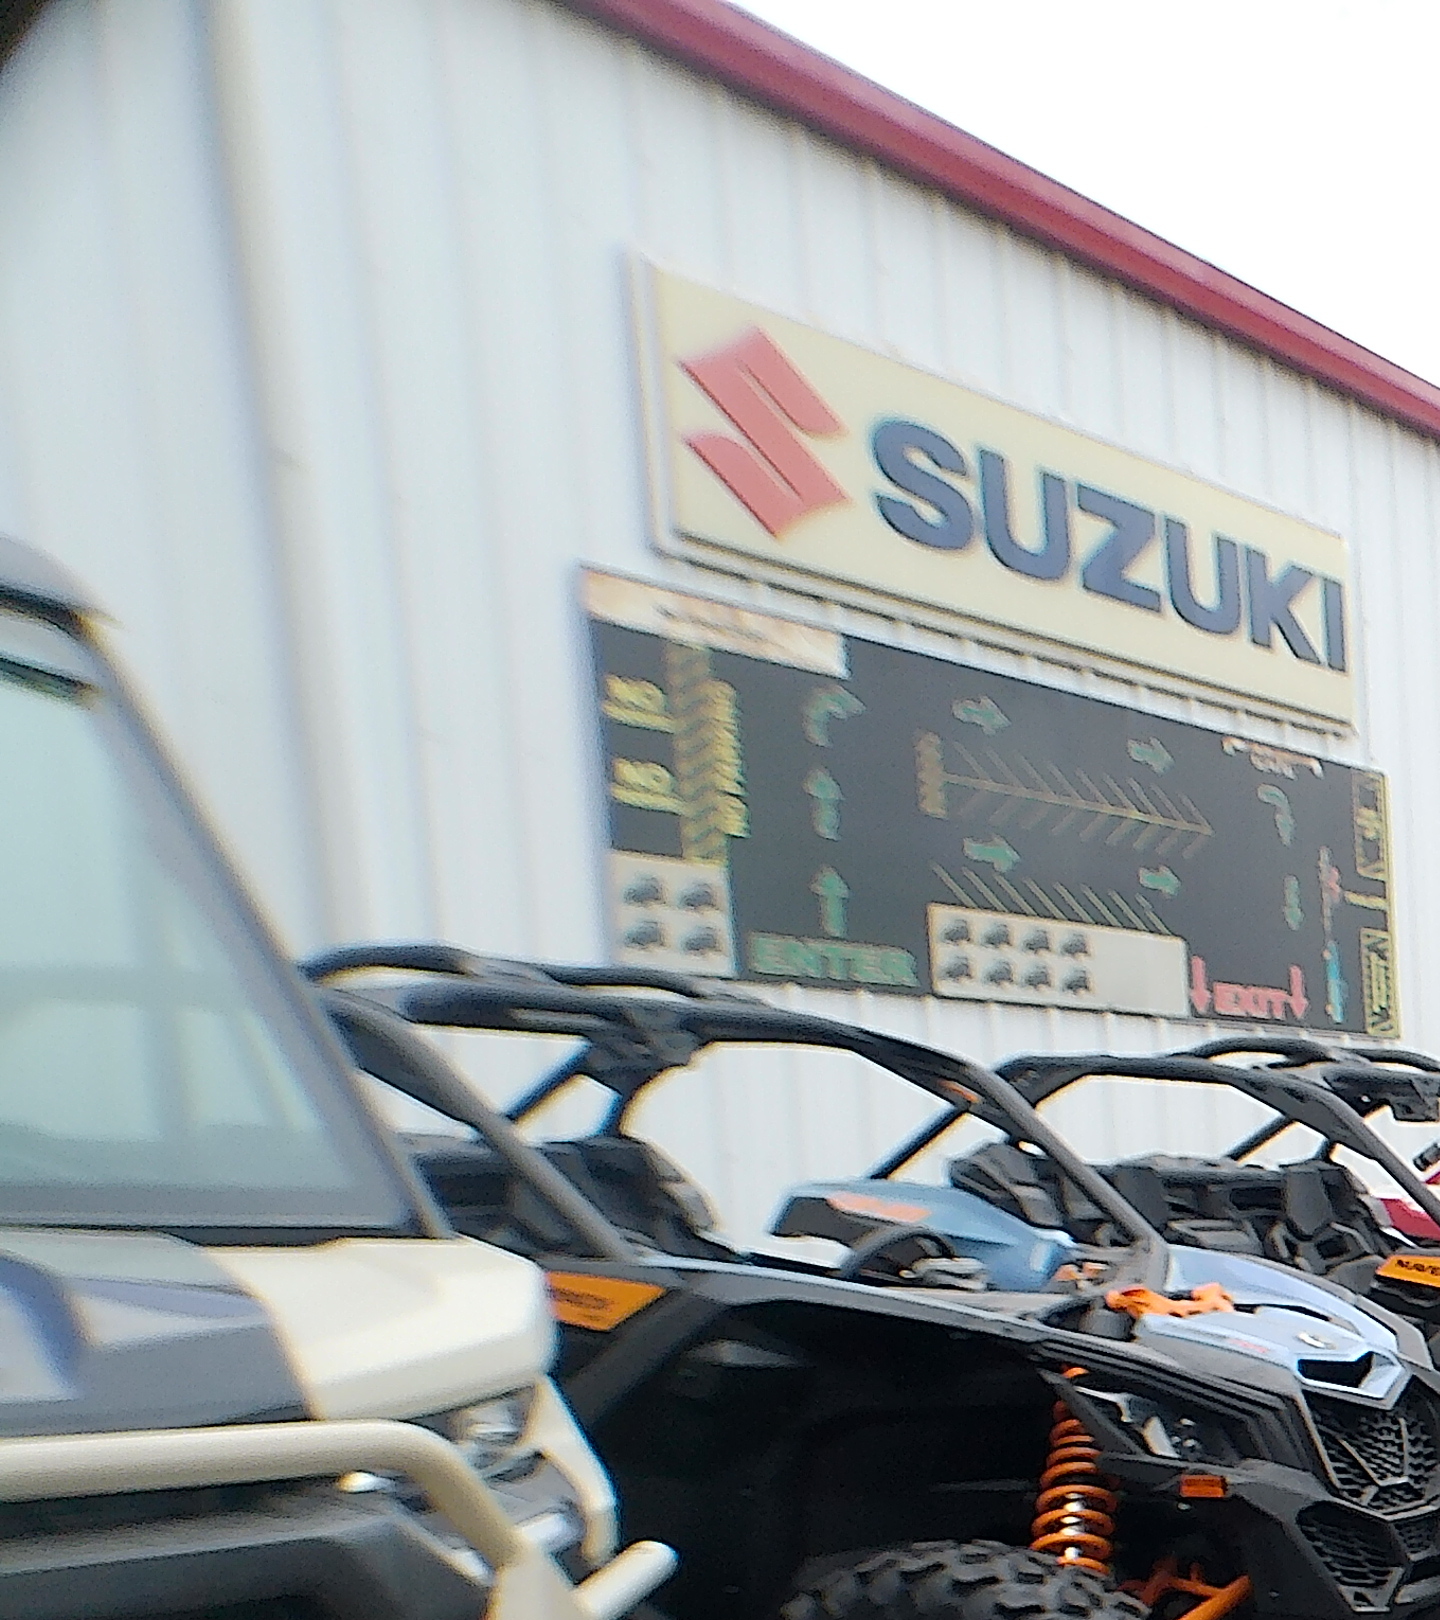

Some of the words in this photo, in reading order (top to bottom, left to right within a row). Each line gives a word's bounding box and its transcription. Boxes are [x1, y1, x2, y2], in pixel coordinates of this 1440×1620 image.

[872, 419, 1347, 673] SUZUKI
[749, 932, 920, 987] ENTER
[1213, 981, 1289, 1020] EXIT
